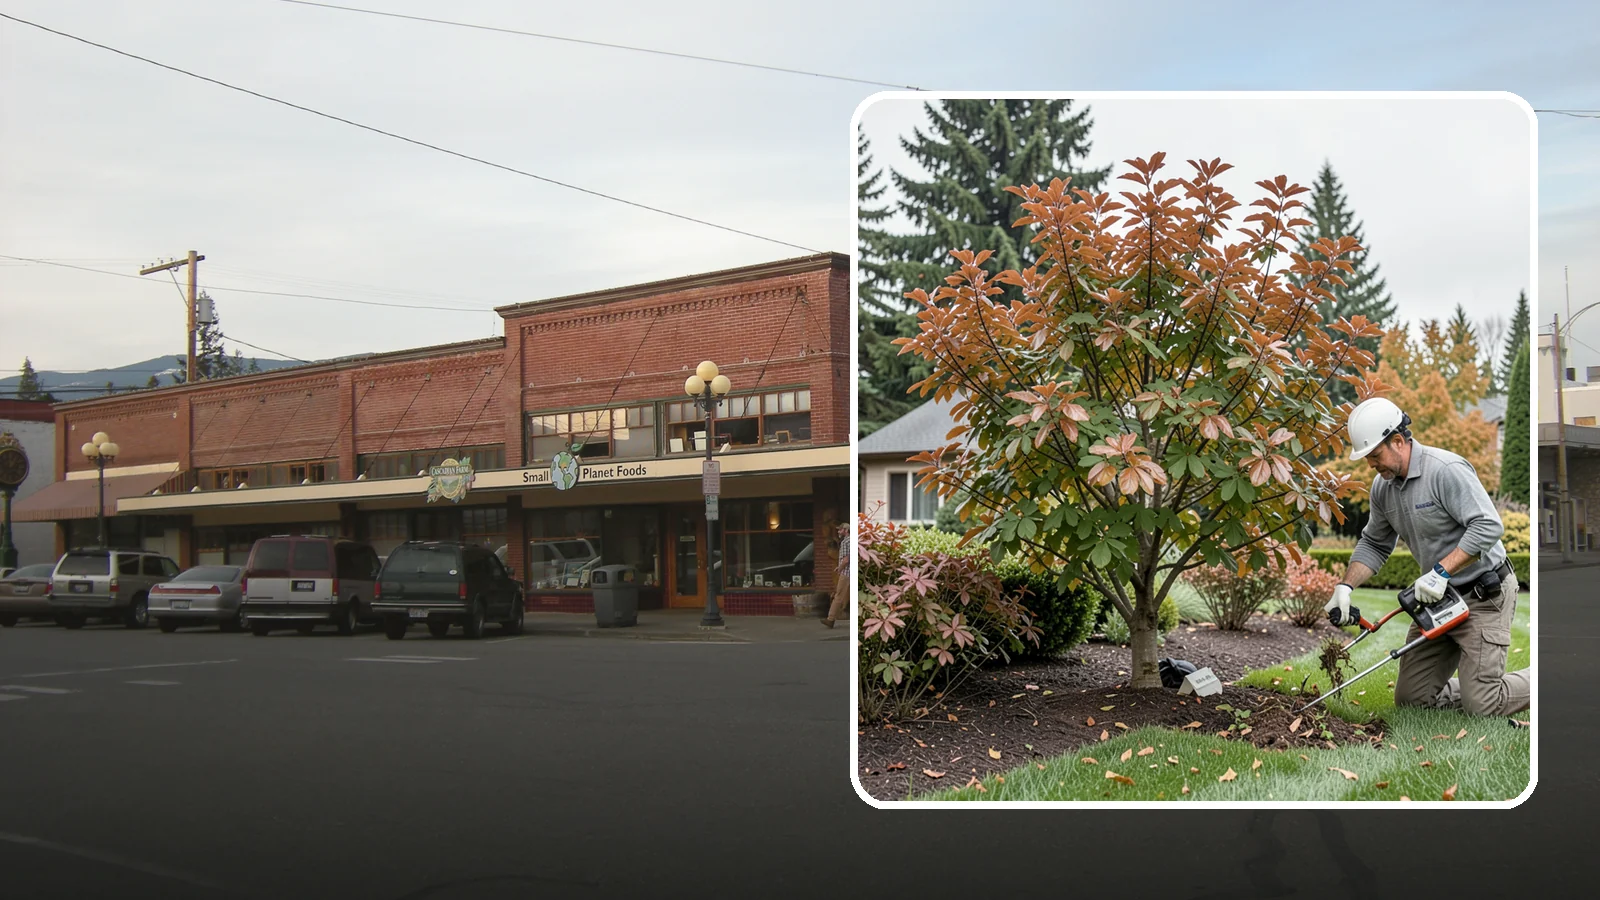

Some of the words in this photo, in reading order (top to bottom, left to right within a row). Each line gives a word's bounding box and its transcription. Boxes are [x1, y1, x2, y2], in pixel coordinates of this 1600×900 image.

[523, 471, 549, 483] Small
[583, 467, 614, 479] Planet
[617, 464, 647, 477] Foods
